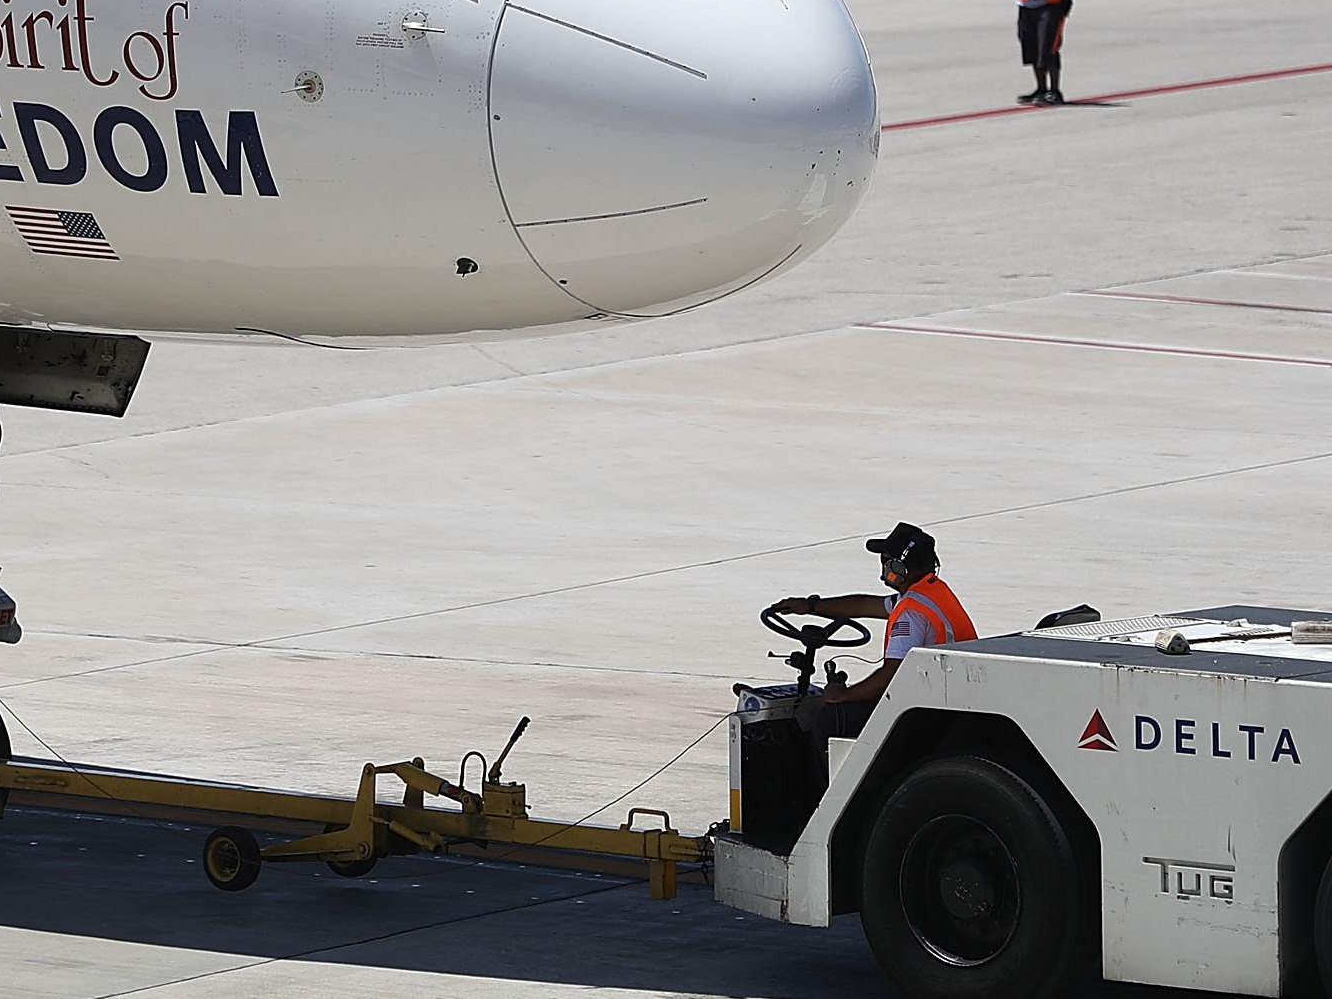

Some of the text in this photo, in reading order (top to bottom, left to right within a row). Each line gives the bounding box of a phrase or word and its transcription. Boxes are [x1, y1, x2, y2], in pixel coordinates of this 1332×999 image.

[122, 1, 188, 100] of
[1134, 715, 1301, 765] DELTA
[1142, 856, 1236, 900] TUG
